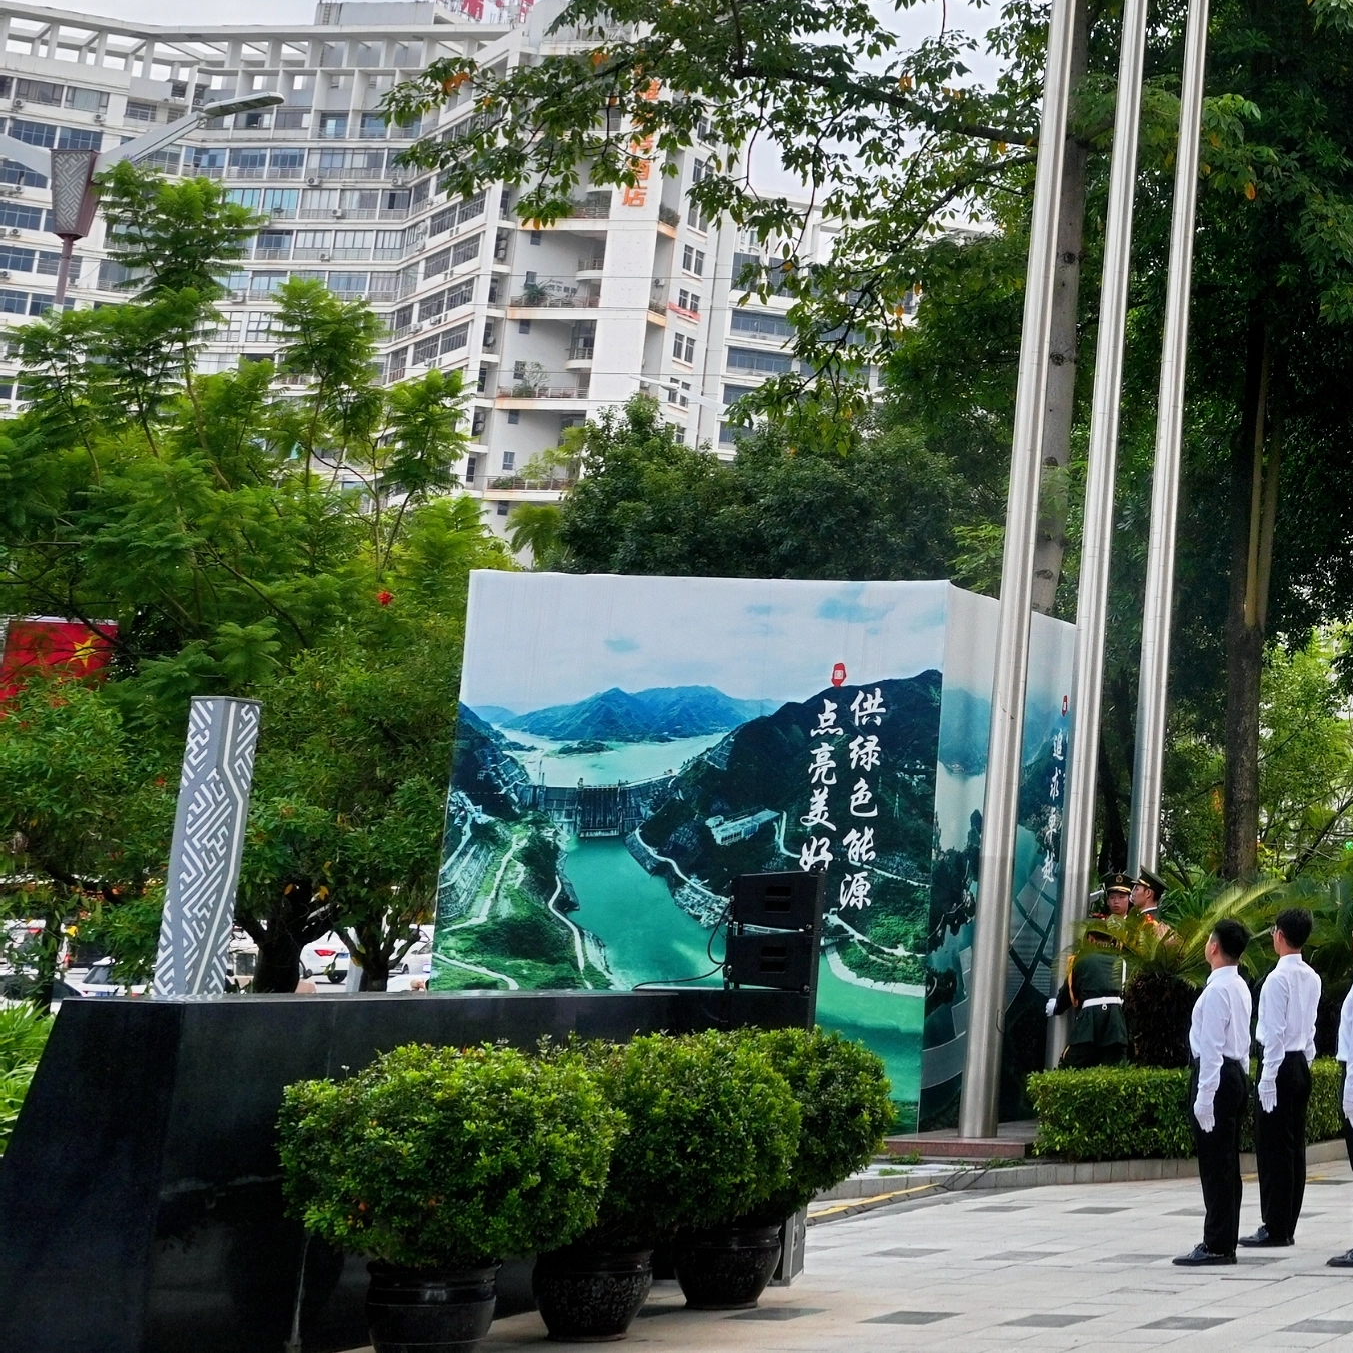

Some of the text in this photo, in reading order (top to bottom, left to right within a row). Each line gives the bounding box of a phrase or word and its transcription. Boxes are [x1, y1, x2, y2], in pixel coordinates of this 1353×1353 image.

[799, 698, 845, 873] 点亮美好
[839, 687, 887, 912] 供绿色能源
